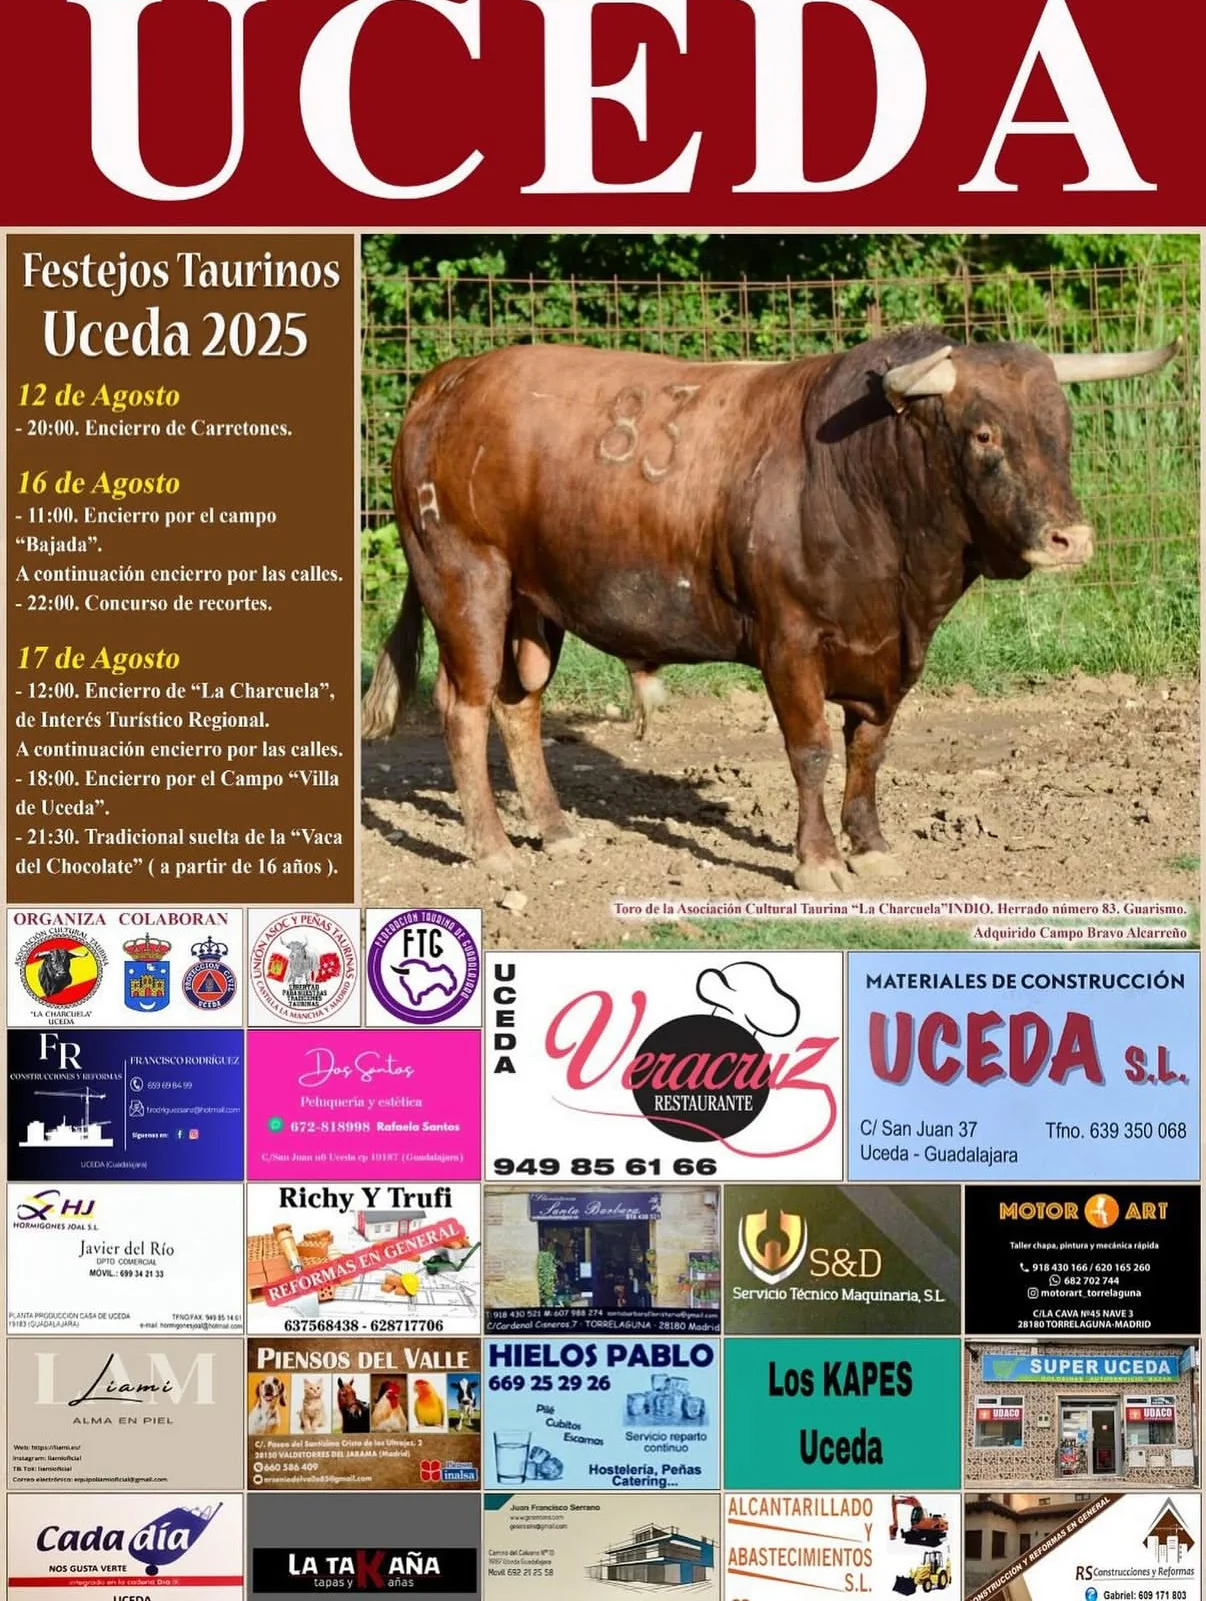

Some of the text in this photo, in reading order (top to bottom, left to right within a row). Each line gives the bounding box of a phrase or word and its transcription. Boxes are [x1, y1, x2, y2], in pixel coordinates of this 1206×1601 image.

[66, 0, 1157, 200] UCEDA
[23, 251, 340, 297] Festejos Taurinos
[43, 305, 308, 357] Uceda 2025
[19, 383, 180, 413] 12 de Agosto
[27, 419, 293, 436] 20:00. Encierro de Carretones.
[18, 470, 180, 501] 16 de Agosto
[29, 506, 277, 528] 11:00. Encierro por el campo
[15, 535, 102, 557] “Bajada”.
[27, 594, 273, 611] 22:00. Concurso de recortes.
[17, 645, 180, 676] 17 de Agosto
[29, 681, 80, 699] 12:00.
[85, 682, 161, 699] Encierro
[165, 682, 186, 699] de
[15, 711, 270, 732] de Interés Turístico Regional.
[613, 902, 643, 914] Toro
[645, 903, 660, 914] de
[663, 903, 674, 914] la
[676, 902, 743, 915] Asociación
[745, 903, 797, 915] Cultural
[800, 902, 848, 915] Taurina
[997, 902, 1049, 915] Herrado
[1052, 903, 1099, 915] número
[1102, 902, 1120, 914] 83.
[1123, 902, 1188, 915] Guarismo.
[13, 912, 228, 926] ORGANIZA COLABORAN
[974, 926, 1188, 941] Adquirido Campo Bravo Alcarreño
[403, 928, 444, 959] FTG
[866, 969, 1185, 990] MATERIALES DE CONSTRUCCIÓN
[493, 964, 517, 1074] UCEDA
[545, 990, 840, 1090] Veracruz
[869, 1009, 1106, 1088] UCEDA
[130, 1054, 240, 1066] FRANCISCO RODRÍGUEZ
[298, 1047, 415, 1088] Dos Santos
[300, 1096, 423, 1110] Peluquería y estética
[654, 1094, 753, 1112] RESTAURANTE
[290, 1121, 371, 1133] 672-818998
[376, 1120, 460, 1132] Rafaela Santos
[860, 1119, 978, 1138] C/ San Juan 37
[1045, 1121, 1187, 1140] Tfno. 639 350 068
[860, 1144, 1018, 1168] Uceda Guadalajara
[493, 1157, 718, 1176] 949 85 61 66
[60, 1199, 97, 1216] HJ
[279, 1187, 453, 1213] Richy Y Trufi
[999, 1201, 1080, 1220] MOTOR
[1124, 1201, 1169, 1220] ART
[78, 1239, 175, 1258] Javier del Río
[268, 1222, 461, 1302] REFORMAS EN GENERAL
[809, 1247, 882, 1278] S&D
[1063, 1276, 1120, 1286] 682 702 744
[732, 1286, 788, 1300] Servicio
[789, 1286, 839, 1301] Técnico
[841, 1288, 922, 1305] Maquinaria,
[1040, 1288, 1142, 1300] motorart_torrelaguna
[284, 1319, 444, 1332] 637568438 628717706
[489, 1343, 715, 1368] HIELOS PABLO
[1029, 1358, 1171, 1375] SUPER UCEDA
[488, 1374, 611, 1392] 669 25 29 26
[768, 1360, 913, 1398] Los KAPES
[72, 1416, 173, 1425] ALMA EN PIEL
[992, 1408, 1020, 1418] UDACO
[1143, 1407, 1173, 1419] UDACO
[799, 1427, 884, 1466] Uceda
[443, 1469, 475, 1480] inalsa
[588, 1463, 702, 1476] Hostelería, Peñas
[612, 1475, 679, 1488] Catering...
[509, 1503, 601, 1512] Juan Francisco Serrano
[728, 1496, 873, 1517] ALCANTARILLADO
[36, 1521, 191, 1551] Cada día
[864, 1522, 873, 1543] Y
[727, 1546, 873, 1568] ABASTECIMIENTOS
[48, 1564, 127, 1573] NOS GUSTA VERTE
[1075, 1566, 1195, 1580] RS Construcciones y Reformas
[313, 1578, 353, 1589] tapas y
[1103, 1590, 1187, 1601] Gabriel: 609 171 803
